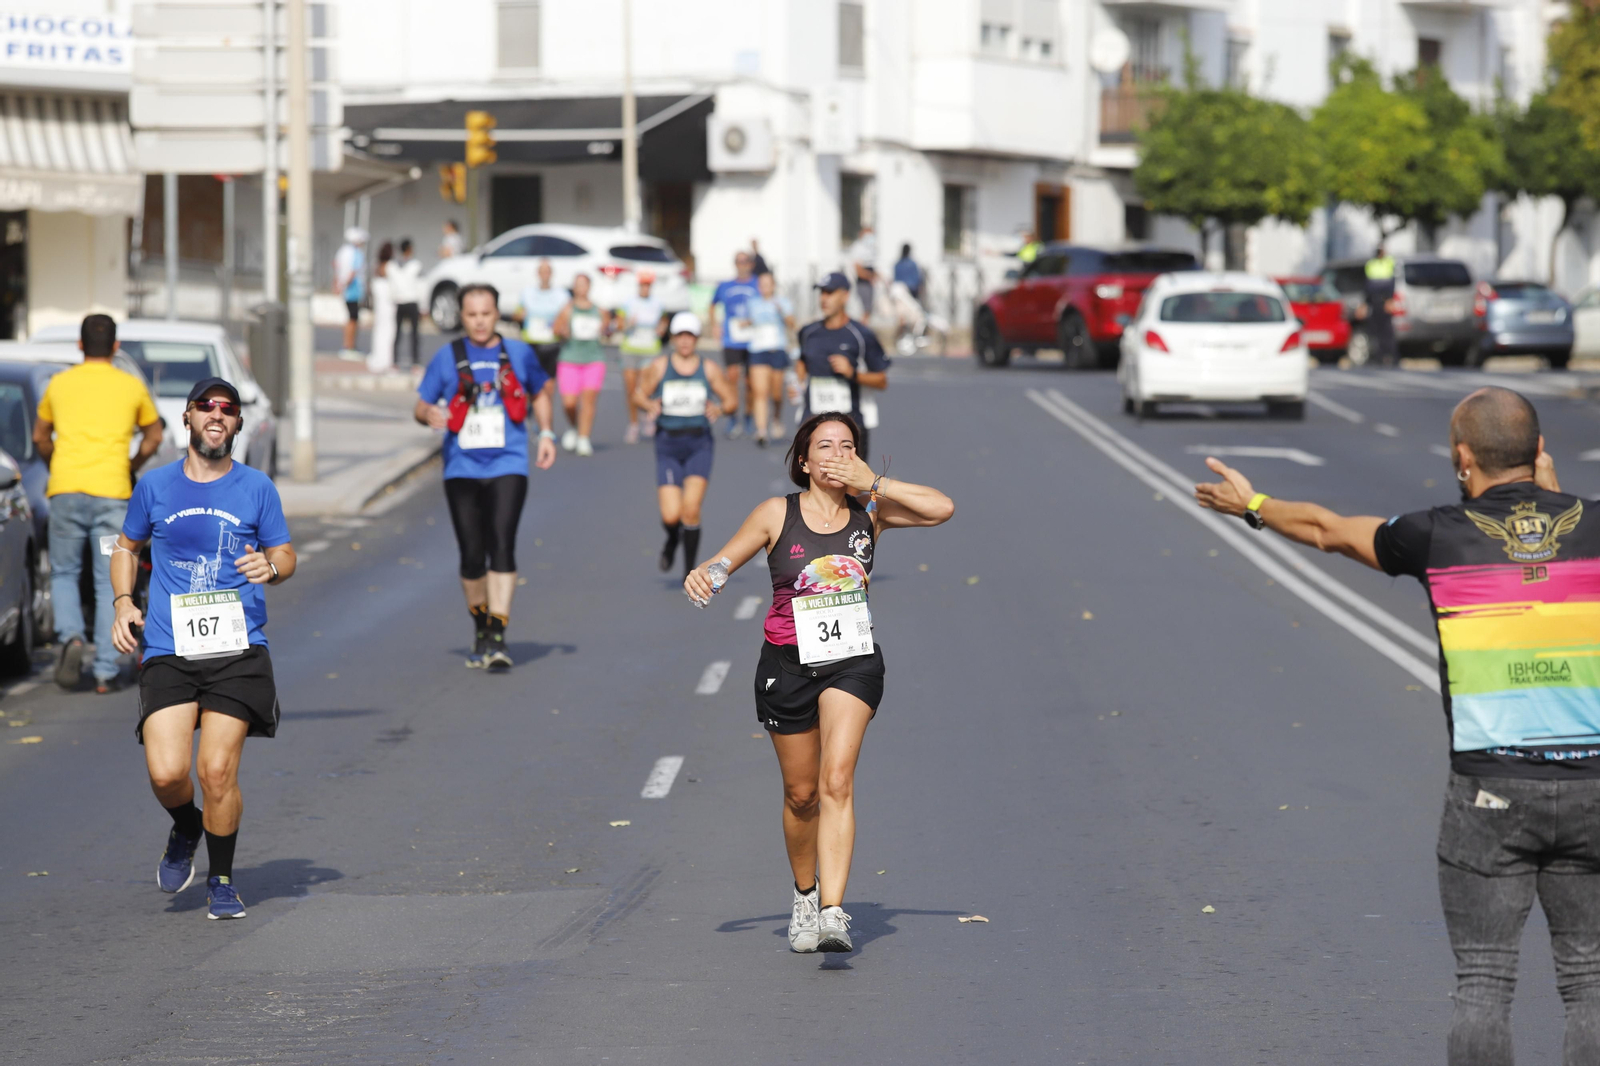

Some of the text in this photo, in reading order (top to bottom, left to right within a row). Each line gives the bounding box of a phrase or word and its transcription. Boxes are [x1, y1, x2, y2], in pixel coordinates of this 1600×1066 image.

[0, 14, 133, 38] HOCOL
[6, 42, 123, 64] FRITAS
[177, 508, 205, 517] VUELTA
[206, 507, 212, 515] A
[213, 508, 240, 526] HUELVA
[185, 595, 208, 606] VUELTA
[209, 595, 214, 603] A
[214, 593, 237, 603] HUELVA
[799, 592, 862, 610] 34 VUELTA A HUELVA
[186, 616, 220, 638] 167
[817, 619, 842, 643] 34
[1507, 660, 1571, 677] IBHOLA
[1509, 675, 1572, 685] TRAIL RUNNING
